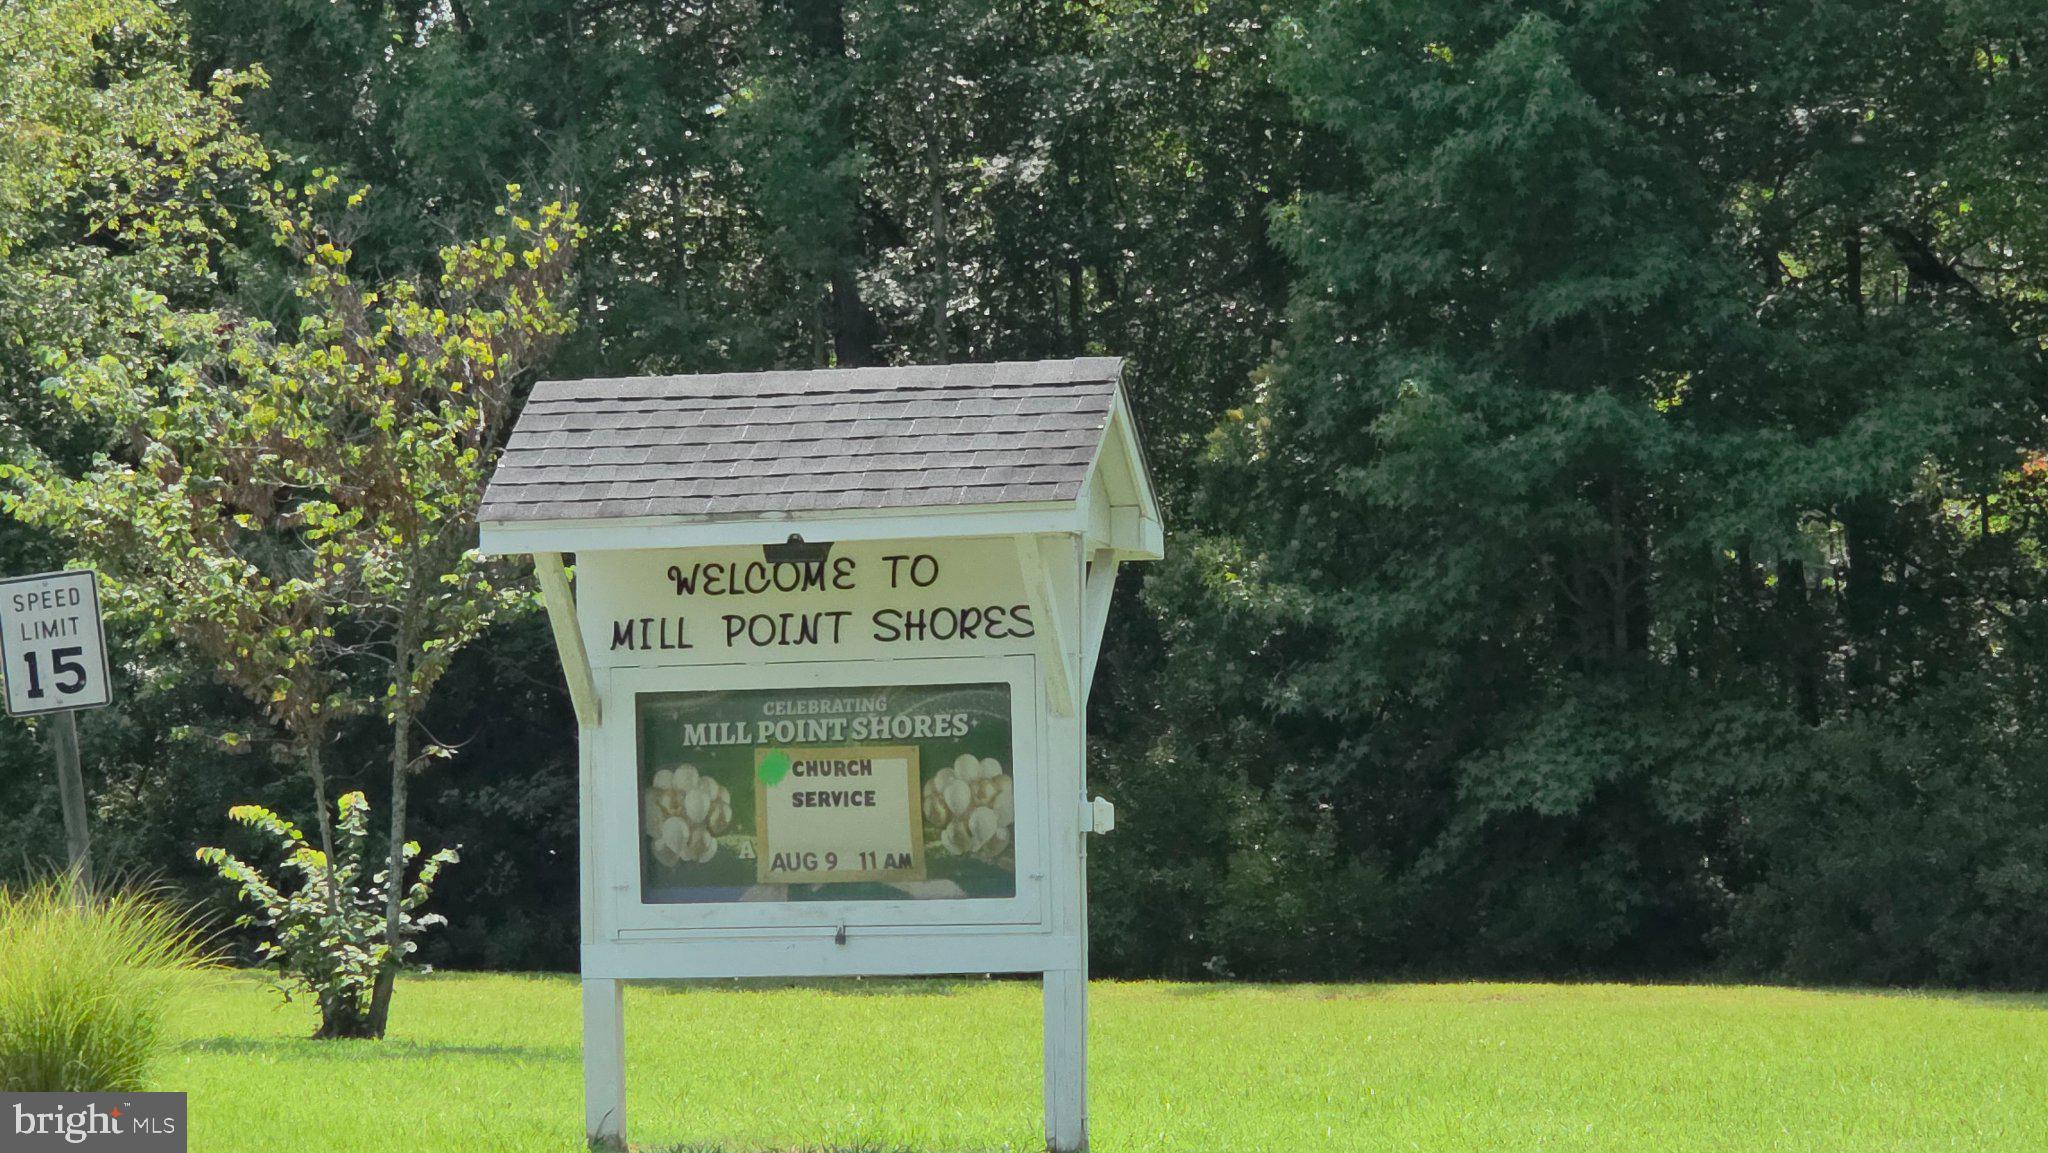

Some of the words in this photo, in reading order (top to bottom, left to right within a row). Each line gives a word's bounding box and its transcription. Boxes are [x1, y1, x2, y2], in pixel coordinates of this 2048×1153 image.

[667, 557, 856, 596] WELCOME
[882, 554, 939, 588] TO
[13, 587, 80, 612] SPEED
[21, 616, 79, 641] LIMIT
[610, 617, 694, 651] MILL
[722, 612, 852, 647] POINT
[872, 605, 1035, 643] SHORES
[24, 646, 87, 699] 15
[762, 697, 888, 716] CELEBRATING
[682, 718, 753, 747] MILL
[756, 716, 848, 744] POINT
[848, 713, 969, 741] SHORES
[792, 759, 873, 778] CHURCH
[792, 789, 876, 808] SERVICE
[770, 851, 818, 872] AUG
[825, 851, 838, 871] 9
[859, 850, 877, 870] 11
[884, 852, 913, 869] AM
